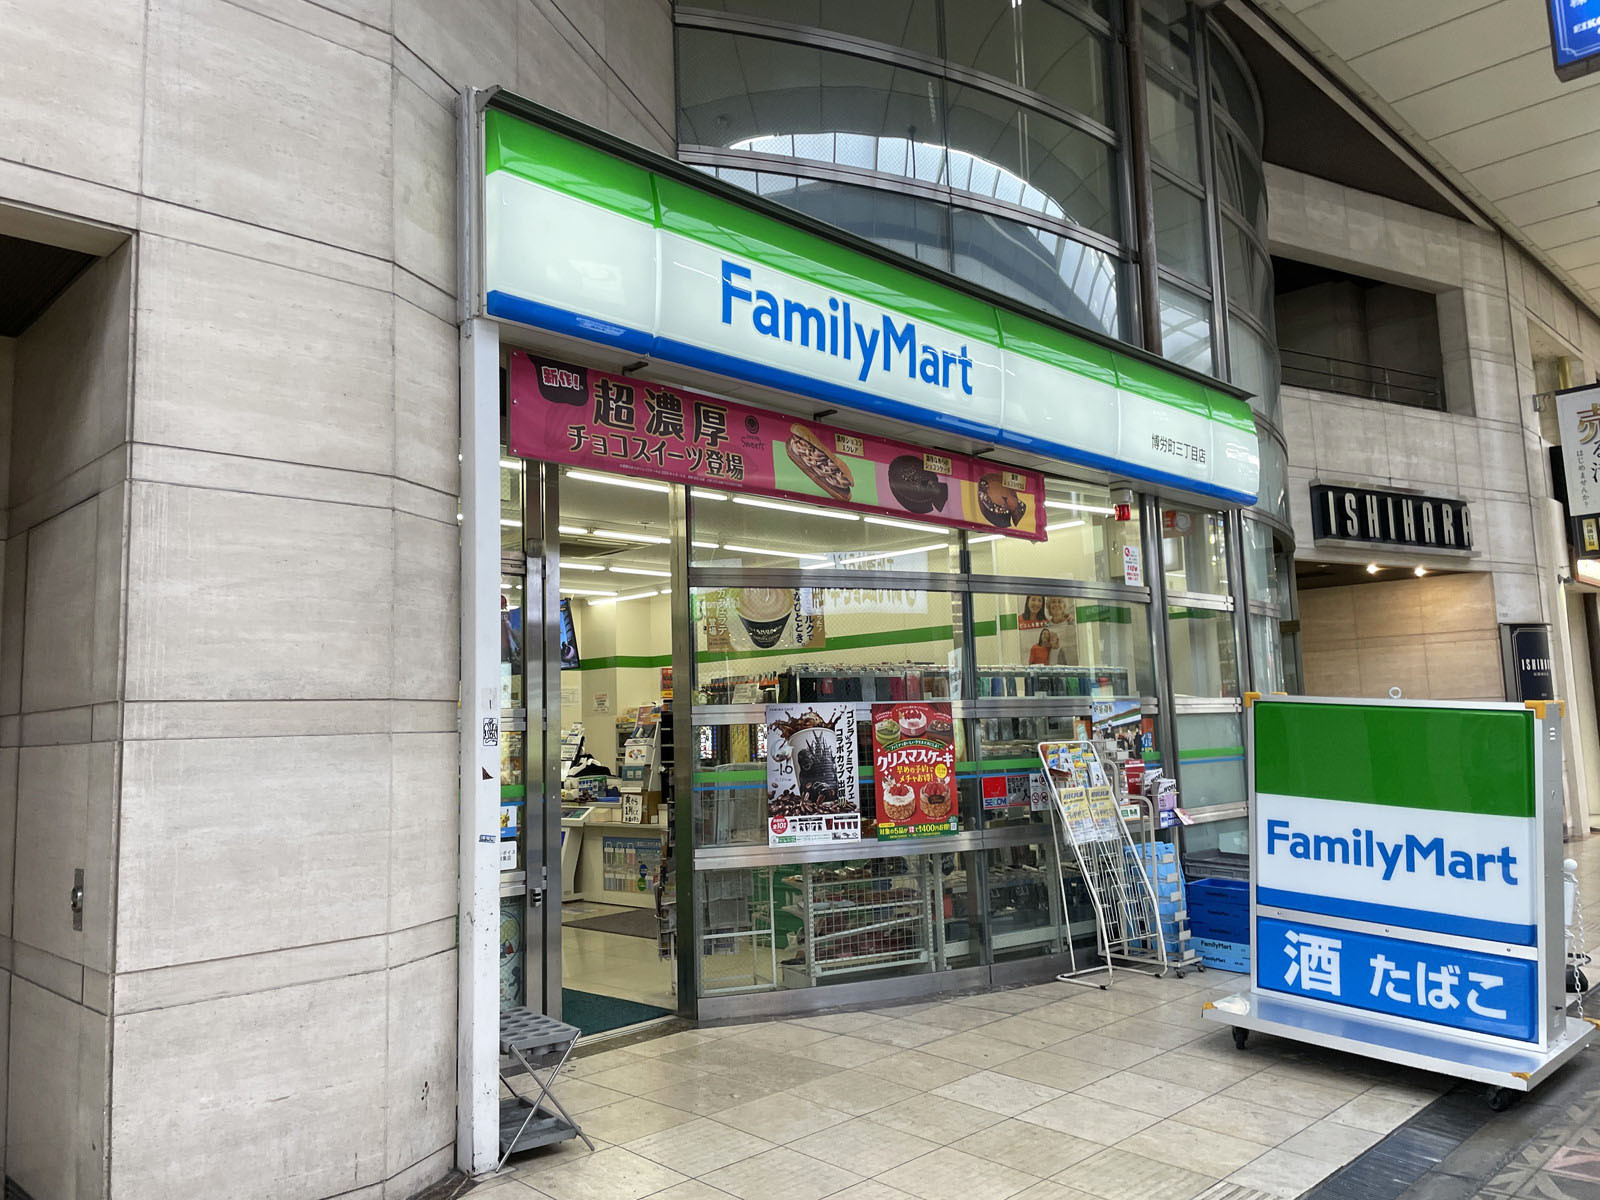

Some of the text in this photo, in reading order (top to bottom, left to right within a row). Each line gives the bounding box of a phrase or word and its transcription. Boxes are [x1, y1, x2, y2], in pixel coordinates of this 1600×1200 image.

[722, 260, 973, 395] FamilyMart
[593, 378, 729, 447] 超濃厚
[566, 424, 745, 482] チョコスイーツ登場
[1151, 433, 1206, 464] 博労町三丁目店
[1326, 490, 1474, 547] ISHIHARA
[877, 749, 953, 772] クリスマスケーキ
[985, 798, 1007, 806] SECOM
[1266, 819, 1519, 886] FamilyMart
[1200, 940, 1232, 951] FamilyMart
[1283, 930, 1508, 1020] 酒 たばこ
